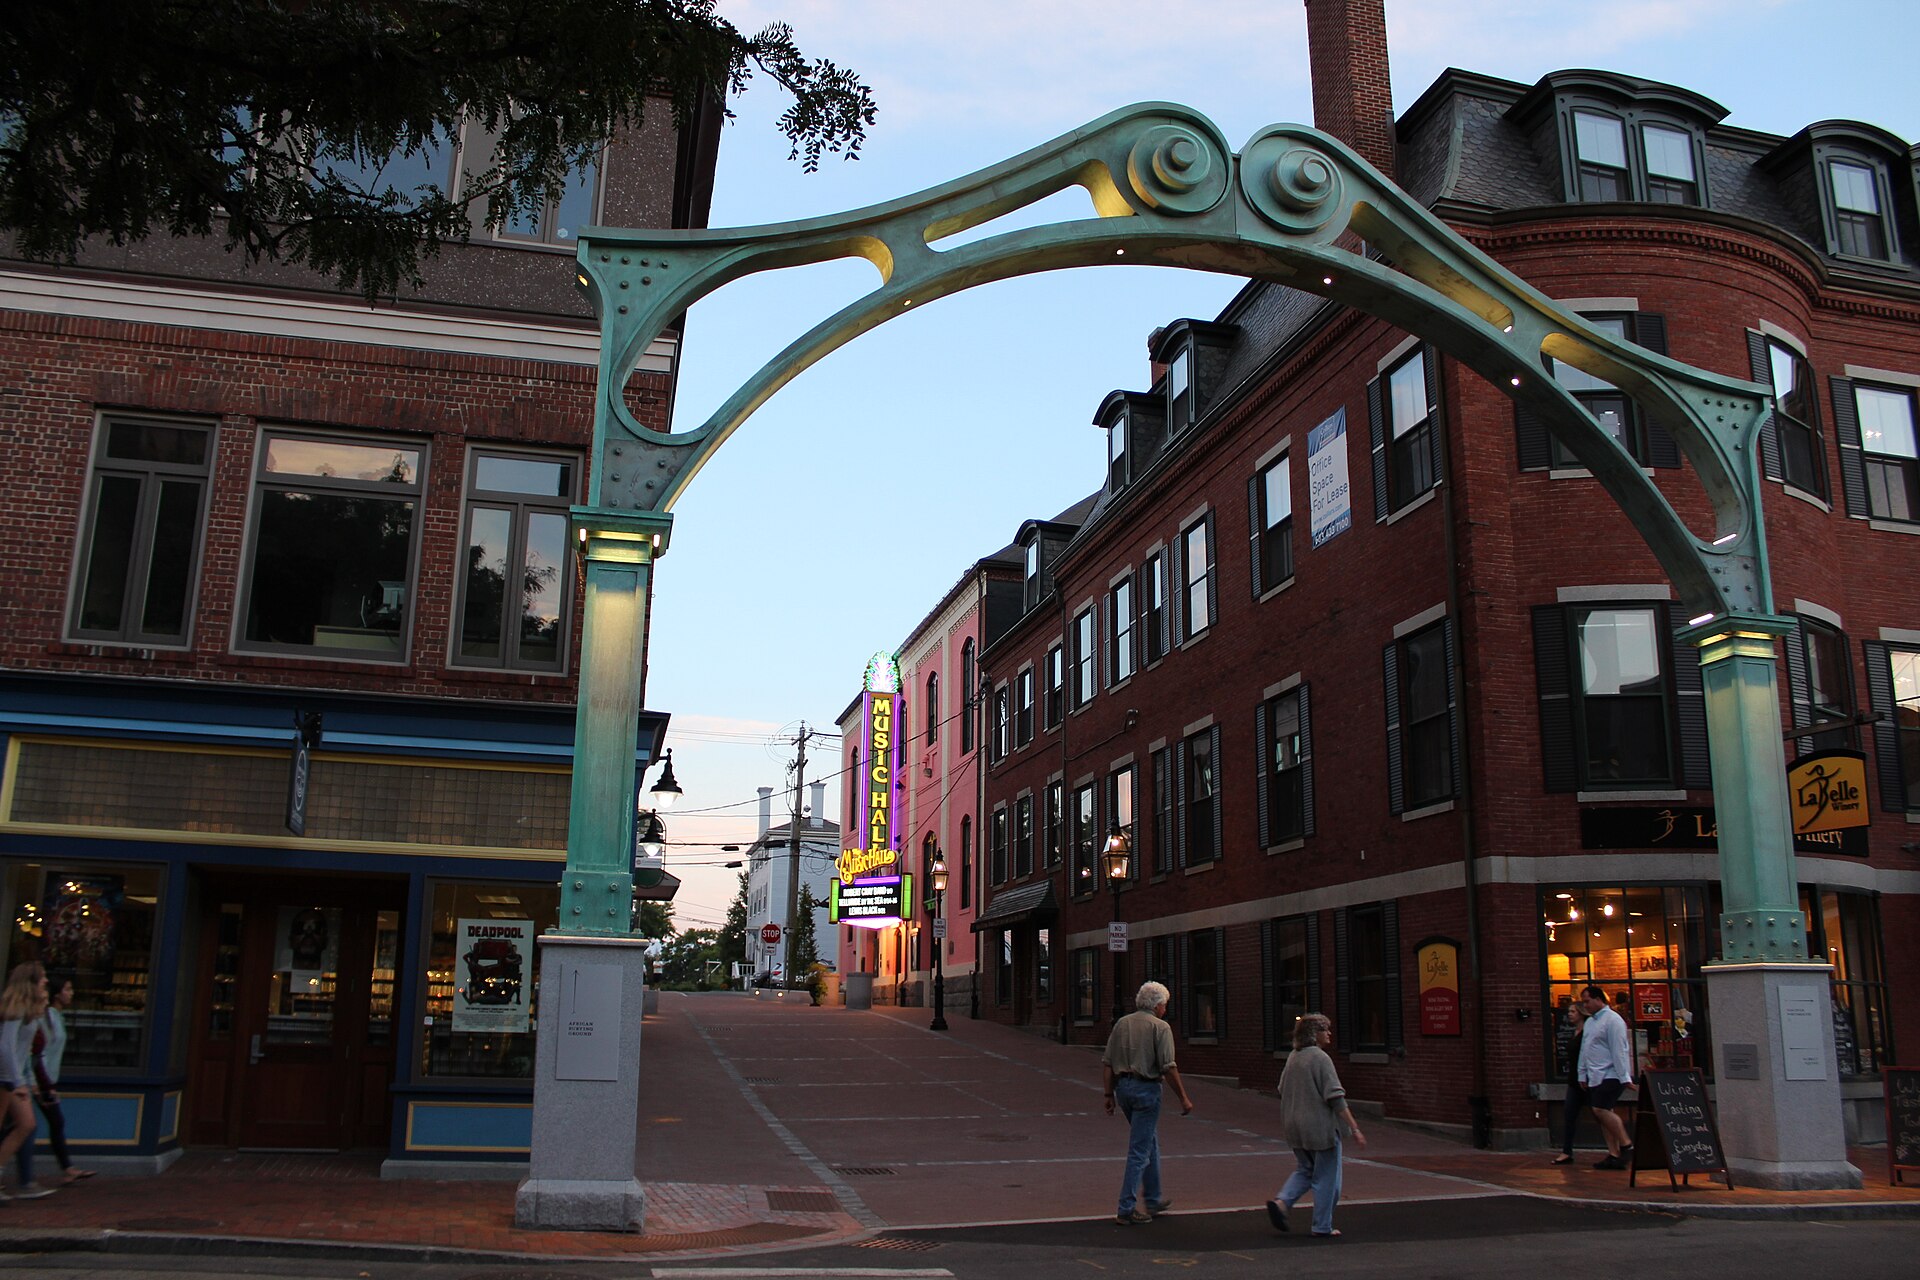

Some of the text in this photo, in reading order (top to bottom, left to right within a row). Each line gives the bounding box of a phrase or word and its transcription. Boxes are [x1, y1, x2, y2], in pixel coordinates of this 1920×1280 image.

[1311, 455, 1332, 477] Office
[1312, 472, 1334, 496] Space
[1312, 482, 1348, 514] For Lease
[871, 698, 890, 784] MUSIC
[1796, 776, 1859, 815] LaBelle
[1831, 802, 1859, 811] Winery
[862, 906, 878, 915] BLACK
[468, 926, 524, 938] DEADPOOL
[762, 930, 780, 938] STOP
[1657, 1082, 1694, 1096] Wine
[1661, 1102, 1704, 1119] Tasting
[1666, 1122, 1710, 1136] Today and
[1672, 1140, 1714, 1156] Everyday
